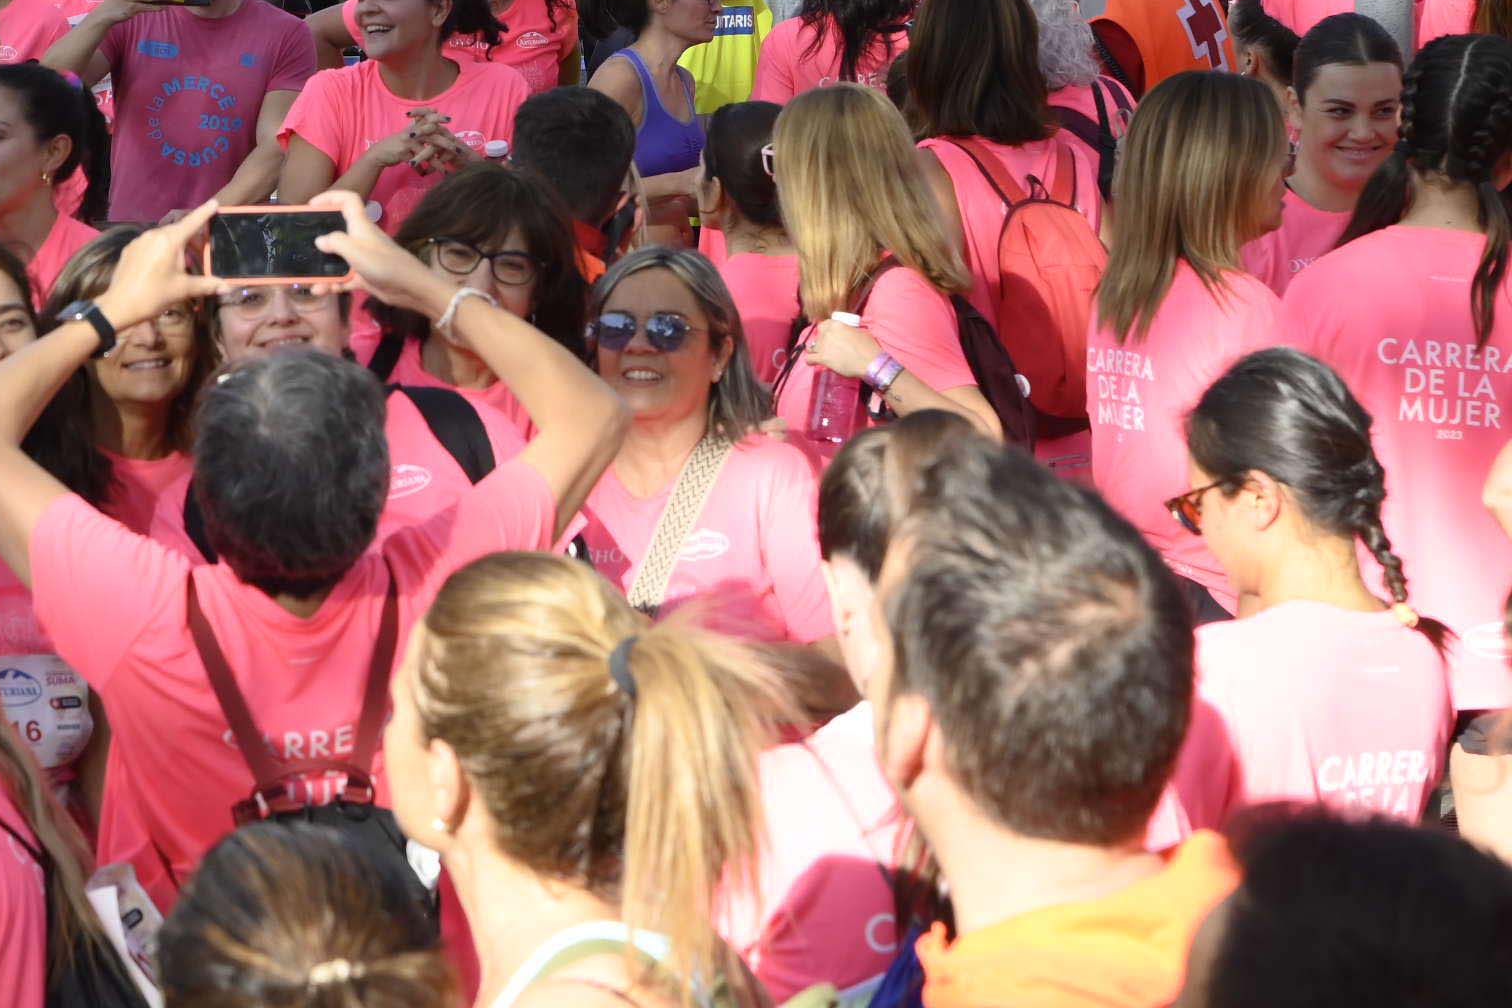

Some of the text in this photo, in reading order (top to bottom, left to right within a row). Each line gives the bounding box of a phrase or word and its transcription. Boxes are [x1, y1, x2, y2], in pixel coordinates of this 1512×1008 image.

[145, 94, 166, 113] la
[147, 117, 164, 140] de
[160, 135, 231, 167] CURSA
[1086, 346, 1155, 382] CARRERA
[1098, 375, 1119, 398] DE
[1404, 367, 1496, 400] DE LA
[1397, 396, 1503, 430] MUJER
[1435, 429, 1464, 441] 2023
